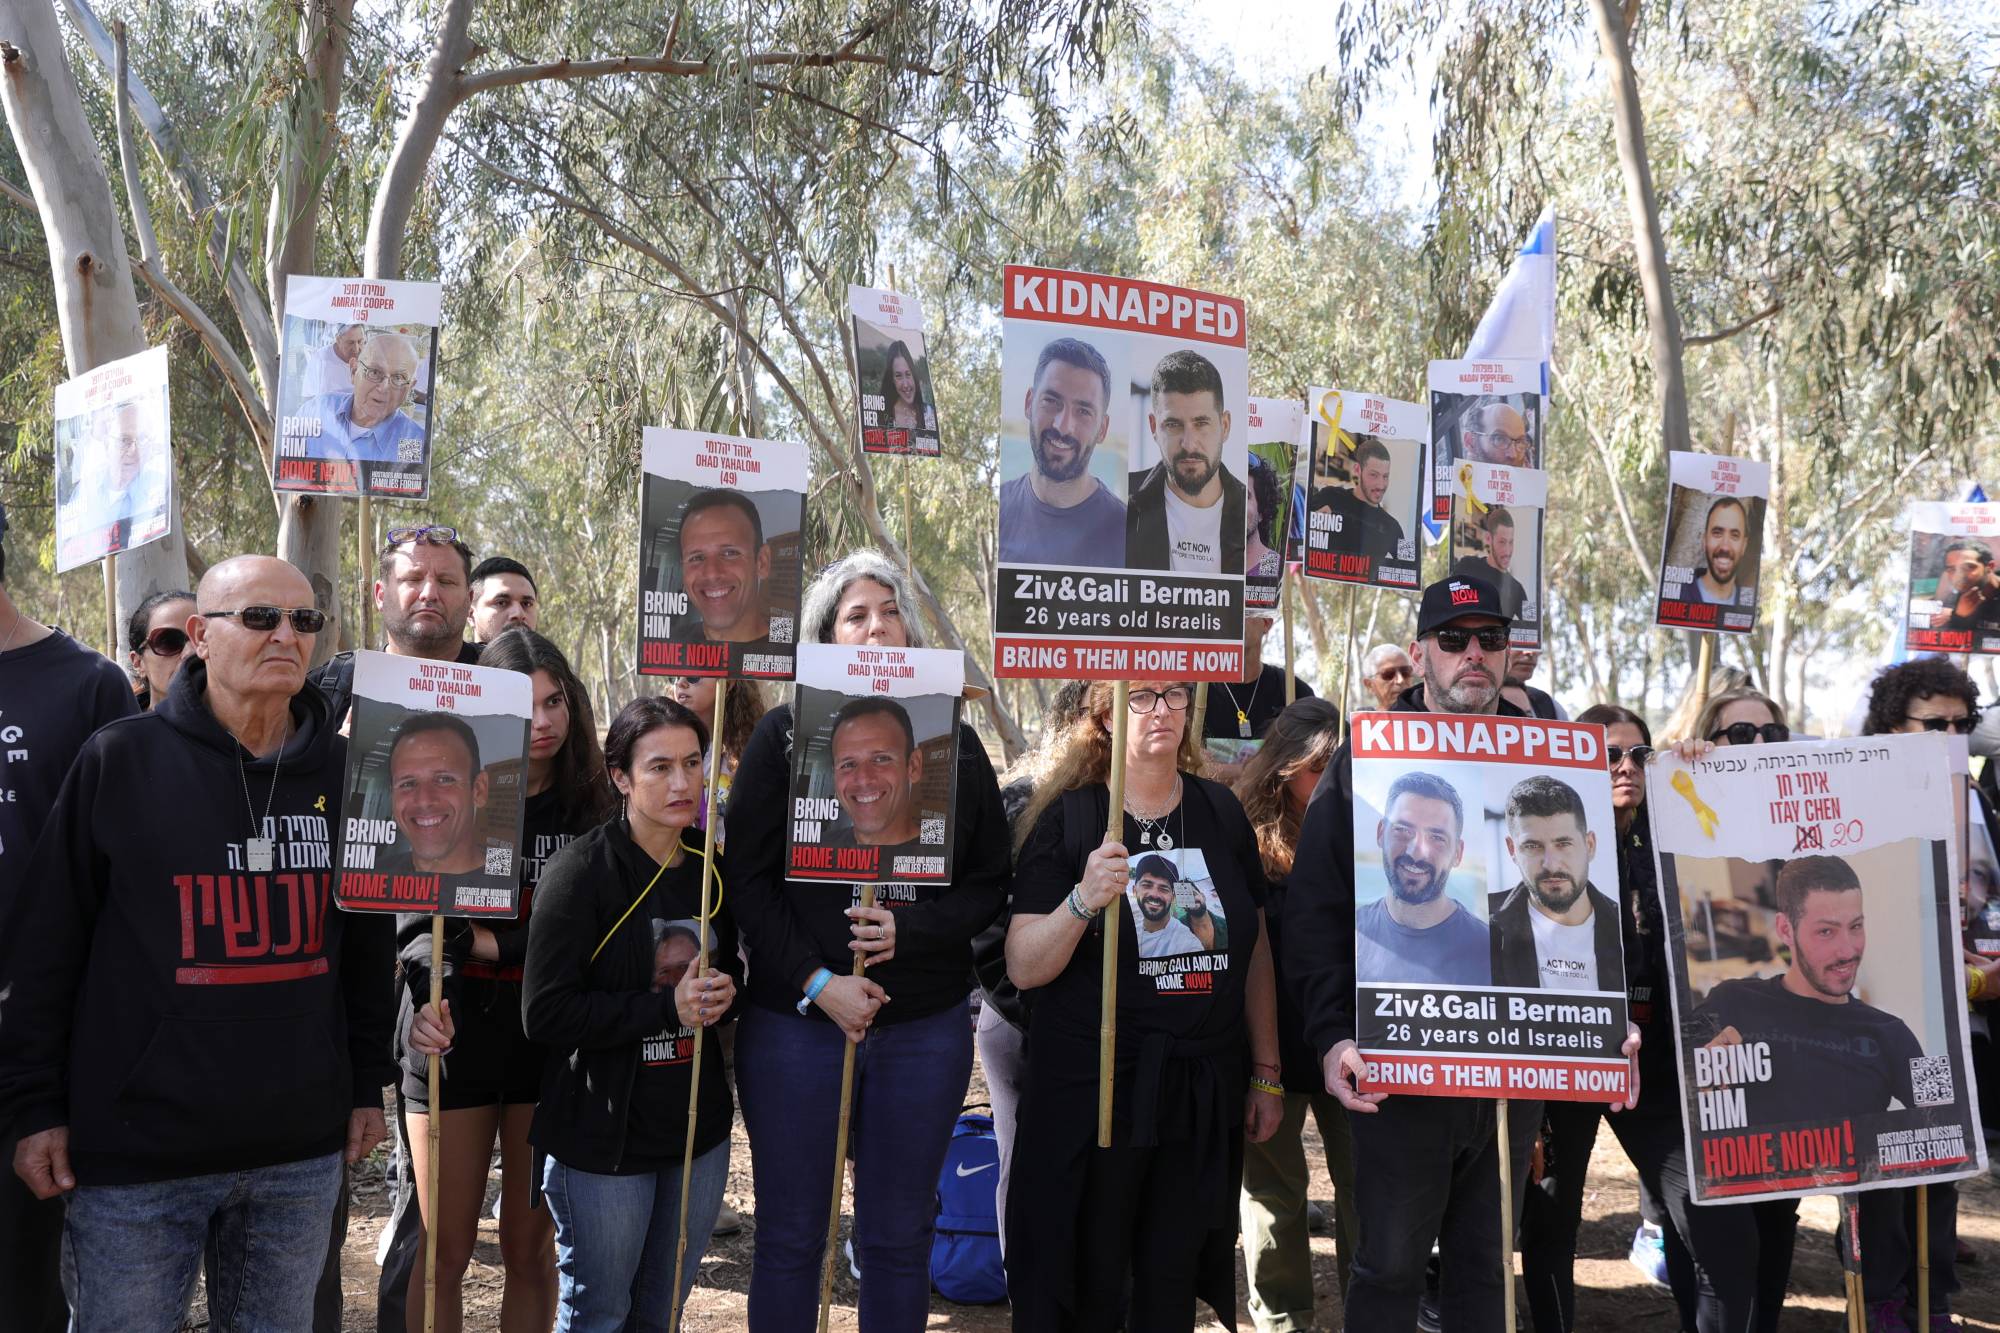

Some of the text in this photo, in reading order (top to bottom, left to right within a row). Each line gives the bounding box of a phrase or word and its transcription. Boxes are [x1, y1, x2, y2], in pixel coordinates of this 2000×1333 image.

[342, 283, 386, 297] עמירם קופר
[363, 297, 394, 310] COOPER
[1013, 274, 1239, 338] KIDNAPPED
[1459, 374, 1514, 383] NADAV POPPLEWELL
[863, 394, 885, 411] BRING
[282, 416, 321, 437] BRING
[864, 410, 878, 427] HER
[1361, 409, 1388, 424] ITAY CHEN
[281, 437, 306, 457] HIM
[705, 440, 752, 458] אוהד יהלומי
[280, 460, 357, 482] HOME NOW!
[696, 454, 761, 473] OHAD YAHALOMI
[371, 478, 422, 490] FAMILIES FORUM
[720, 471, 737, 486] (49)
[1435, 496, 1450, 512] HO
[1310, 511, 1342, 532] BRING
[1177, 541, 1211, 554] ACT NOW
[1309, 530, 1329, 550] HIM
[1308, 550, 1337, 571] HOME
[1340, 555, 1370, 575] NOW!
[1665, 566, 1694, 584] BRING
[1014, 574, 1230, 607] Ziv&Gali Berman
[1451, 589, 1478, 602] NOW
[1662, 582, 1681, 600] HIM
[644, 590, 688, 616] BRING
[1661, 601, 1686, 617] HOME
[1689, 604, 1717, 620] NOW!
[643, 616, 671, 639] HIM
[1025, 606, 1221, 630] 26 years old Israelis
[642, 641, 729, 668] HOME NOW!
[857, 650, 906, 664] אוהד יהלומי
[1003, 646, 1239, 672] BRING THEM HOME NOW!
[420, 664, 472, 682] אוהד יהלומי
[742, 661, 793, 674] FAMILIES FORUM
[848, 663, 915, 679] OHAD YAHALOMI
[409, 677, 482, 697] OHAD YAHALOMI
[872, 679, 889, 693] (49)
[436, 694, 455, 710] (49)
[1361, 719, 1598, 762] KIDNAPPED
[1813, 747, 1853, 765] לחזור
[1860, 748, 1890, 762] חייב
[1776, 771, 1829, 800] איתי חן
[794, 797, 839, 821] BRING
[1770, 797, 1841, 825] ITAY CHEN
[345, 817, 397, 845] BRING
[793, 820, 822, 843] HIM
[1830, 819, 1864, 847] 20
[343, 844, 376, 869] HIM
[792, 846, 880, 871] HOME NOW!
[893, 863, 945, 874] FAMILIES FORUM
[339, 871, 440, 901] HOME NOW!
[480, 888, 490, 897] AND
[888, 884, 917, 901] OHAD
[455, 895, 486, 907] FAMILIES
[486, 896, 511, 909] FORUM
[172, 873, 331, 960] עכשיו
[1138, 954, 1228, 977] BRING GALI AND ZIV
[1547, 959, 1586, 970] ACT NOW
[1155, 972, 1213, 990] HOME NOW!
[1375, 993, 1497, 1021] Ziv&Gali
[1508, 997, 1612, 1025] Berman
[1386, 1024, 1603, 1049] 26 years old Israelis
[642, 1041, 676, 1061] HOME
[1693, 1041, 1773, 1087] BRING
[1366, 1062, 1626, 1093] BRING THEM HOME NOW!
[1698, 1088, 1748, 1131] HIM
[1876, 1124, 1963, 1147] HOSTAGES AND MISSING
[1702, 1120, 1855, 1178] HOME NOW!
[1879, 1138, 1966, 1167] FAMILIES FORUM
